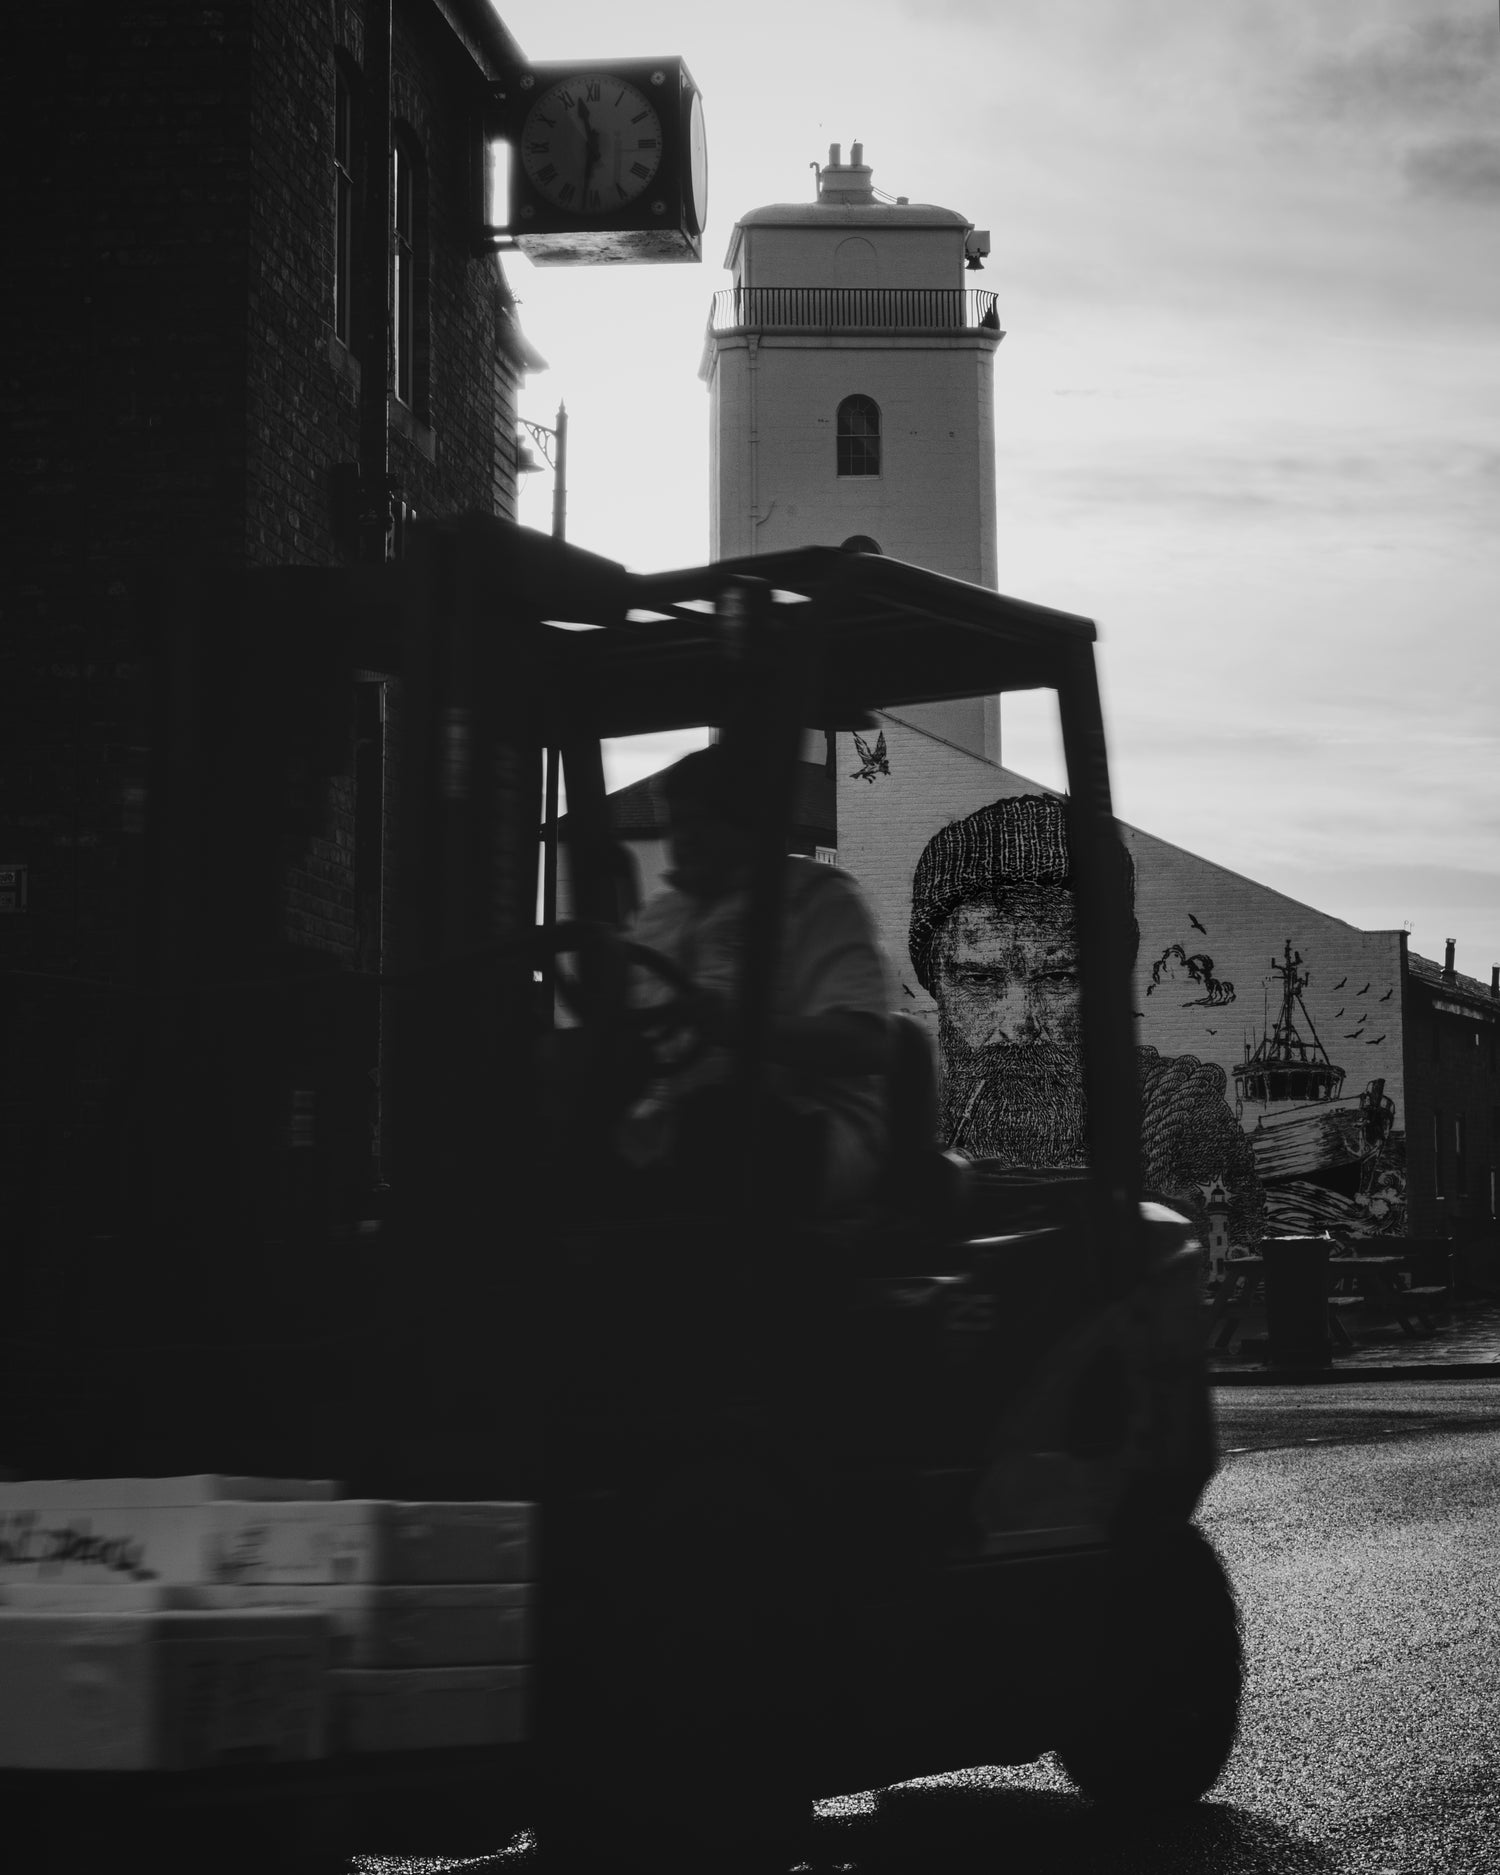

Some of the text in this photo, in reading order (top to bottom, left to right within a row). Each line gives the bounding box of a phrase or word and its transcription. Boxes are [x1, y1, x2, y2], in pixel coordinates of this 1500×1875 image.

[558, 90, 575, 110] XI
[586, 83, 600, 102] XII
[536, 113, 556, 128] X
[631, 110, 649, 124] II
[530, 141, 550, 154] IX
[638, 139, 657, 149] III
[558, 182, 576, 203] VII
[616, 183, 628, 200] V
